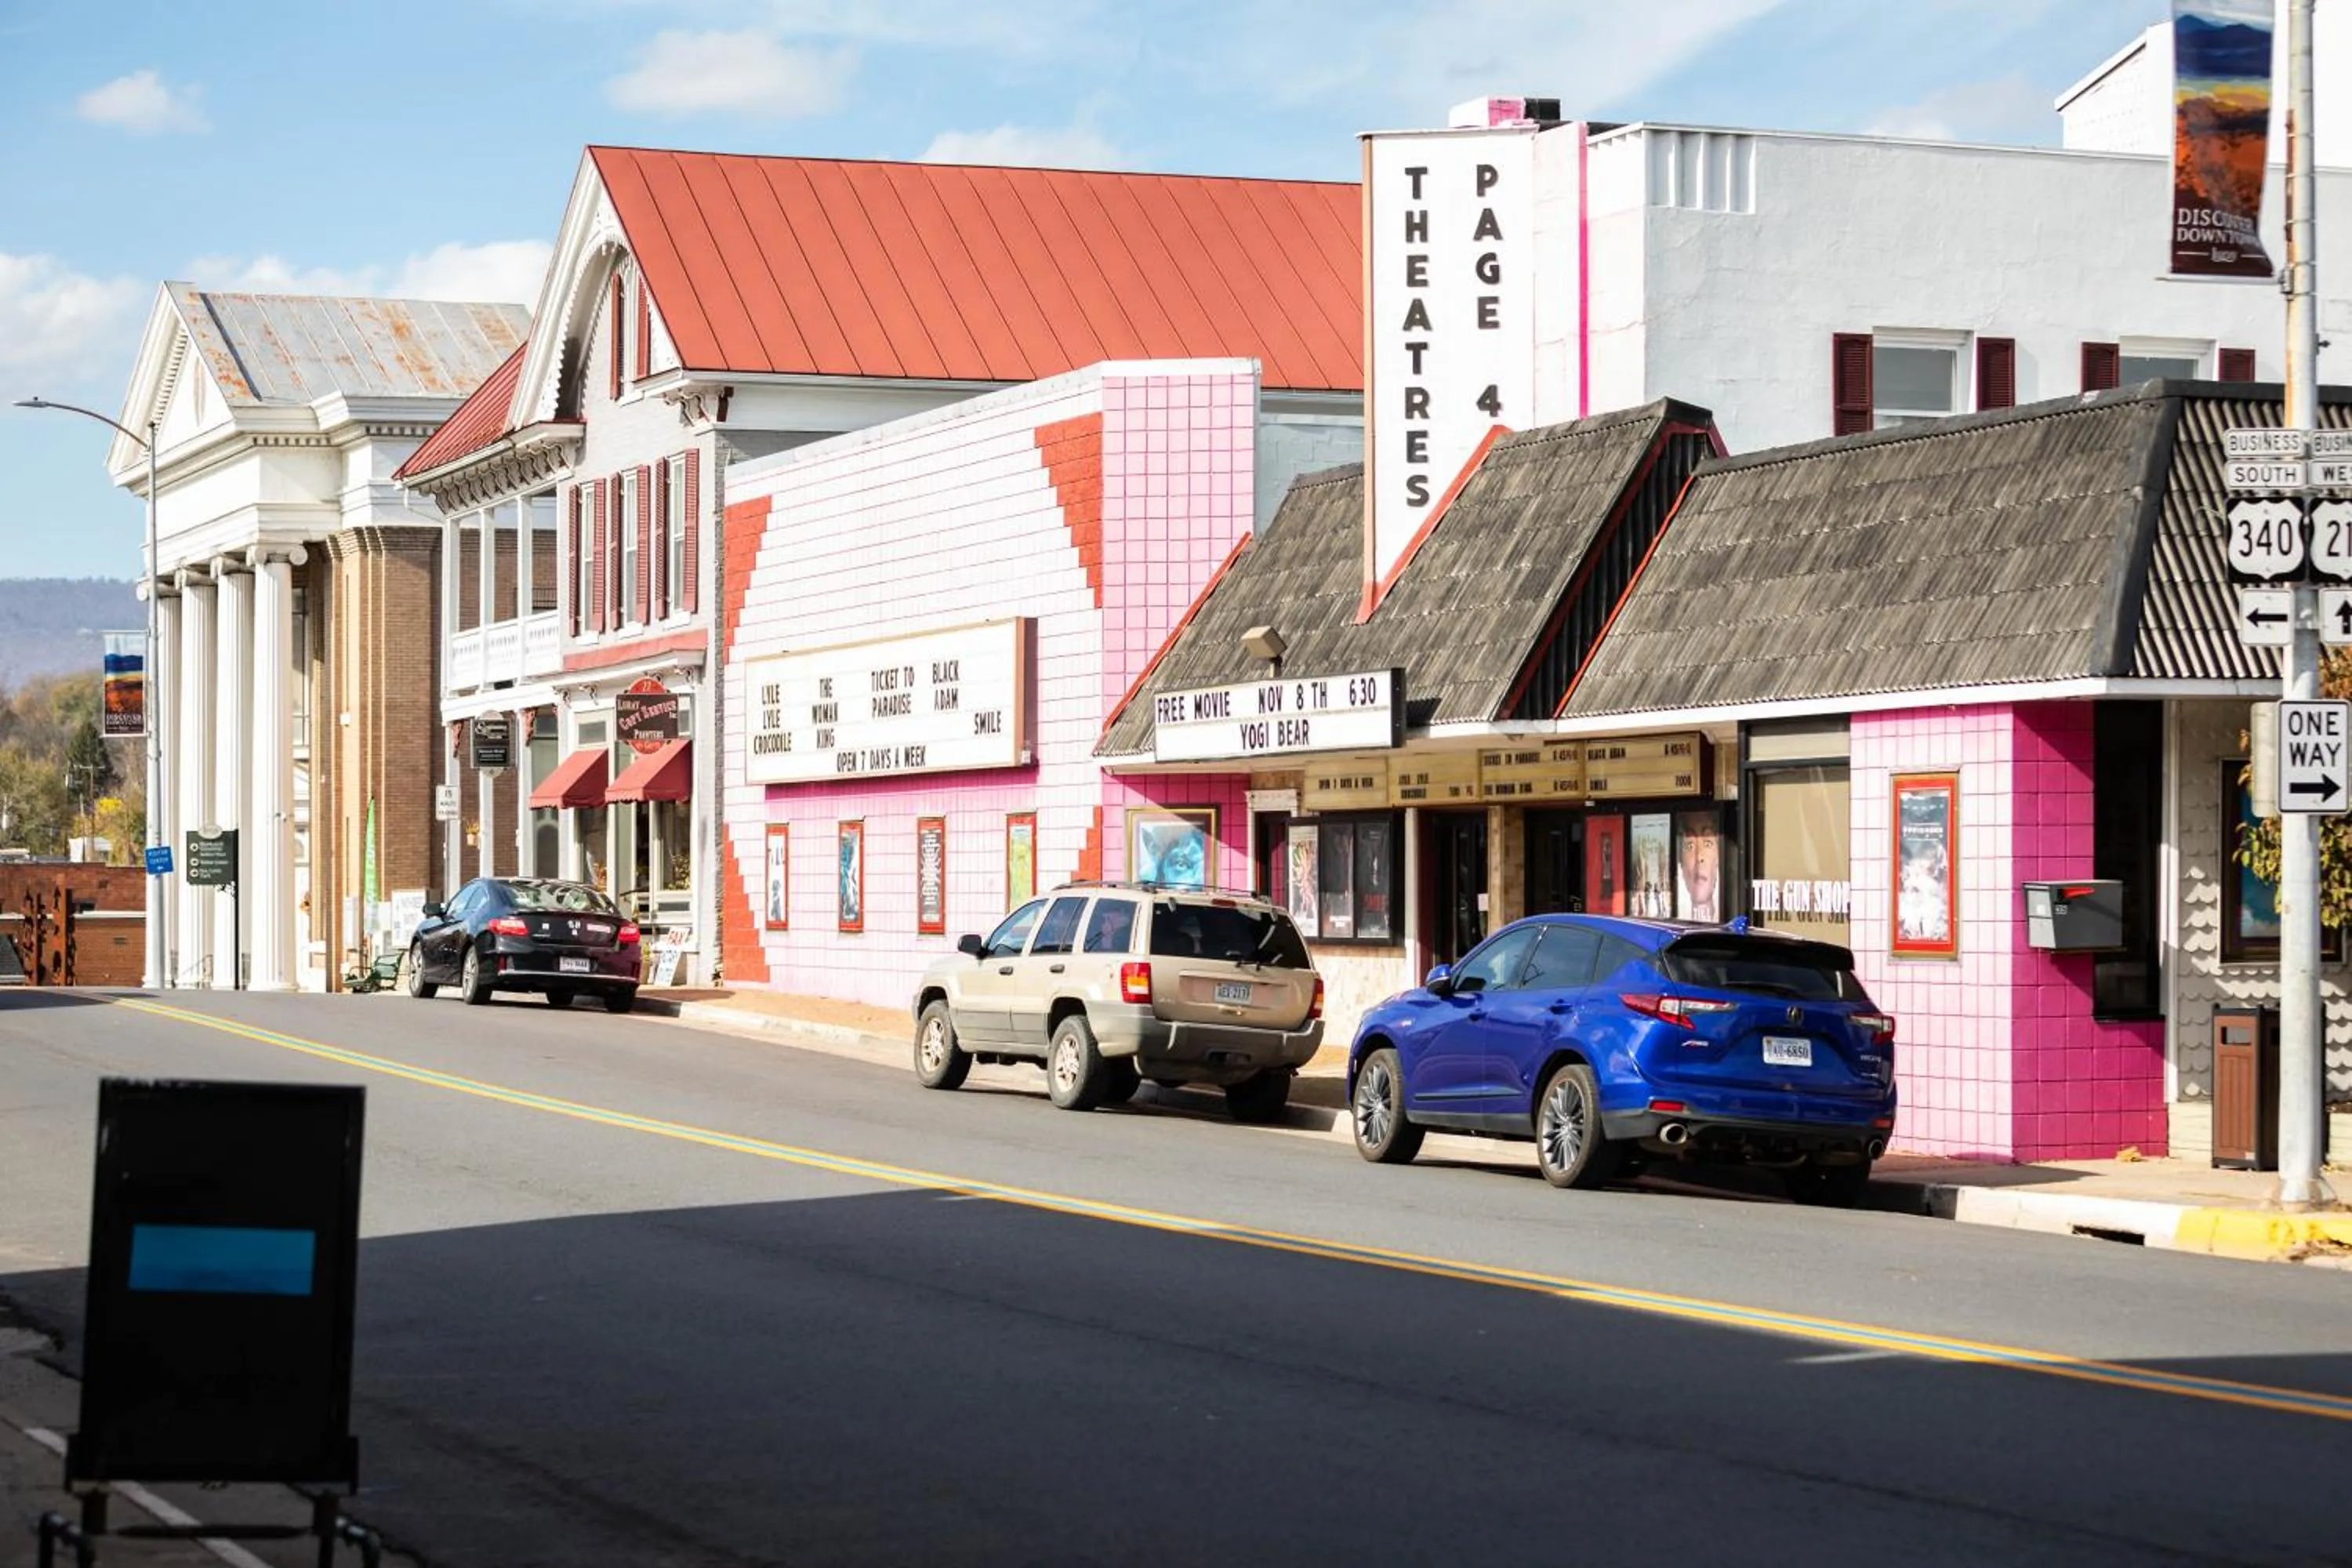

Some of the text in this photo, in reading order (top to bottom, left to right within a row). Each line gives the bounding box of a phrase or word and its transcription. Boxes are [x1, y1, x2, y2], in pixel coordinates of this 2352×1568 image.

[1473, 163, 1503, 417] PAGE 4
[1402, 166, 1433, 508] THEATRES
[2229, 434, 2299, 451] BUSINESS
[2234, 466, 2296, 482] SOUTH
[2322, 466, 2352, 481] WE
[2238, 519, 2293, 557] 340
[871, 666, 915, 692] TICKET TO
[932, 659, 960, 684] BLACK
[761, 684, 780, 706] LYLE
[872, 693, 912, 718] PARADISE
[935, 688, 960, 711] ADAM
[1157, 696, 1185, 724] FREE
[1193, 691, 1231, 720] MOVIE
[1258, 685, 1283, 713] NOV
[1296, 684, 1304, 711] 8
[1311, 681, 1327, 709] TH
[763, 708, 781, 730] LYLE
[975, 710, 1002, 735] SMILE
[2288, 710, 2339, 736] ONE
[753, 731, 792, 755] CROCODILE
[1240, 719, 1310, 750] YOGI BEAR
[837, 745, 927, 772] OPEN 7 DAYS A WEEK
[2289, 742, 2342, 768] WAY
[1752, 880, 1780, 910] THE
[1782, 880, 1810, 911] GUN
